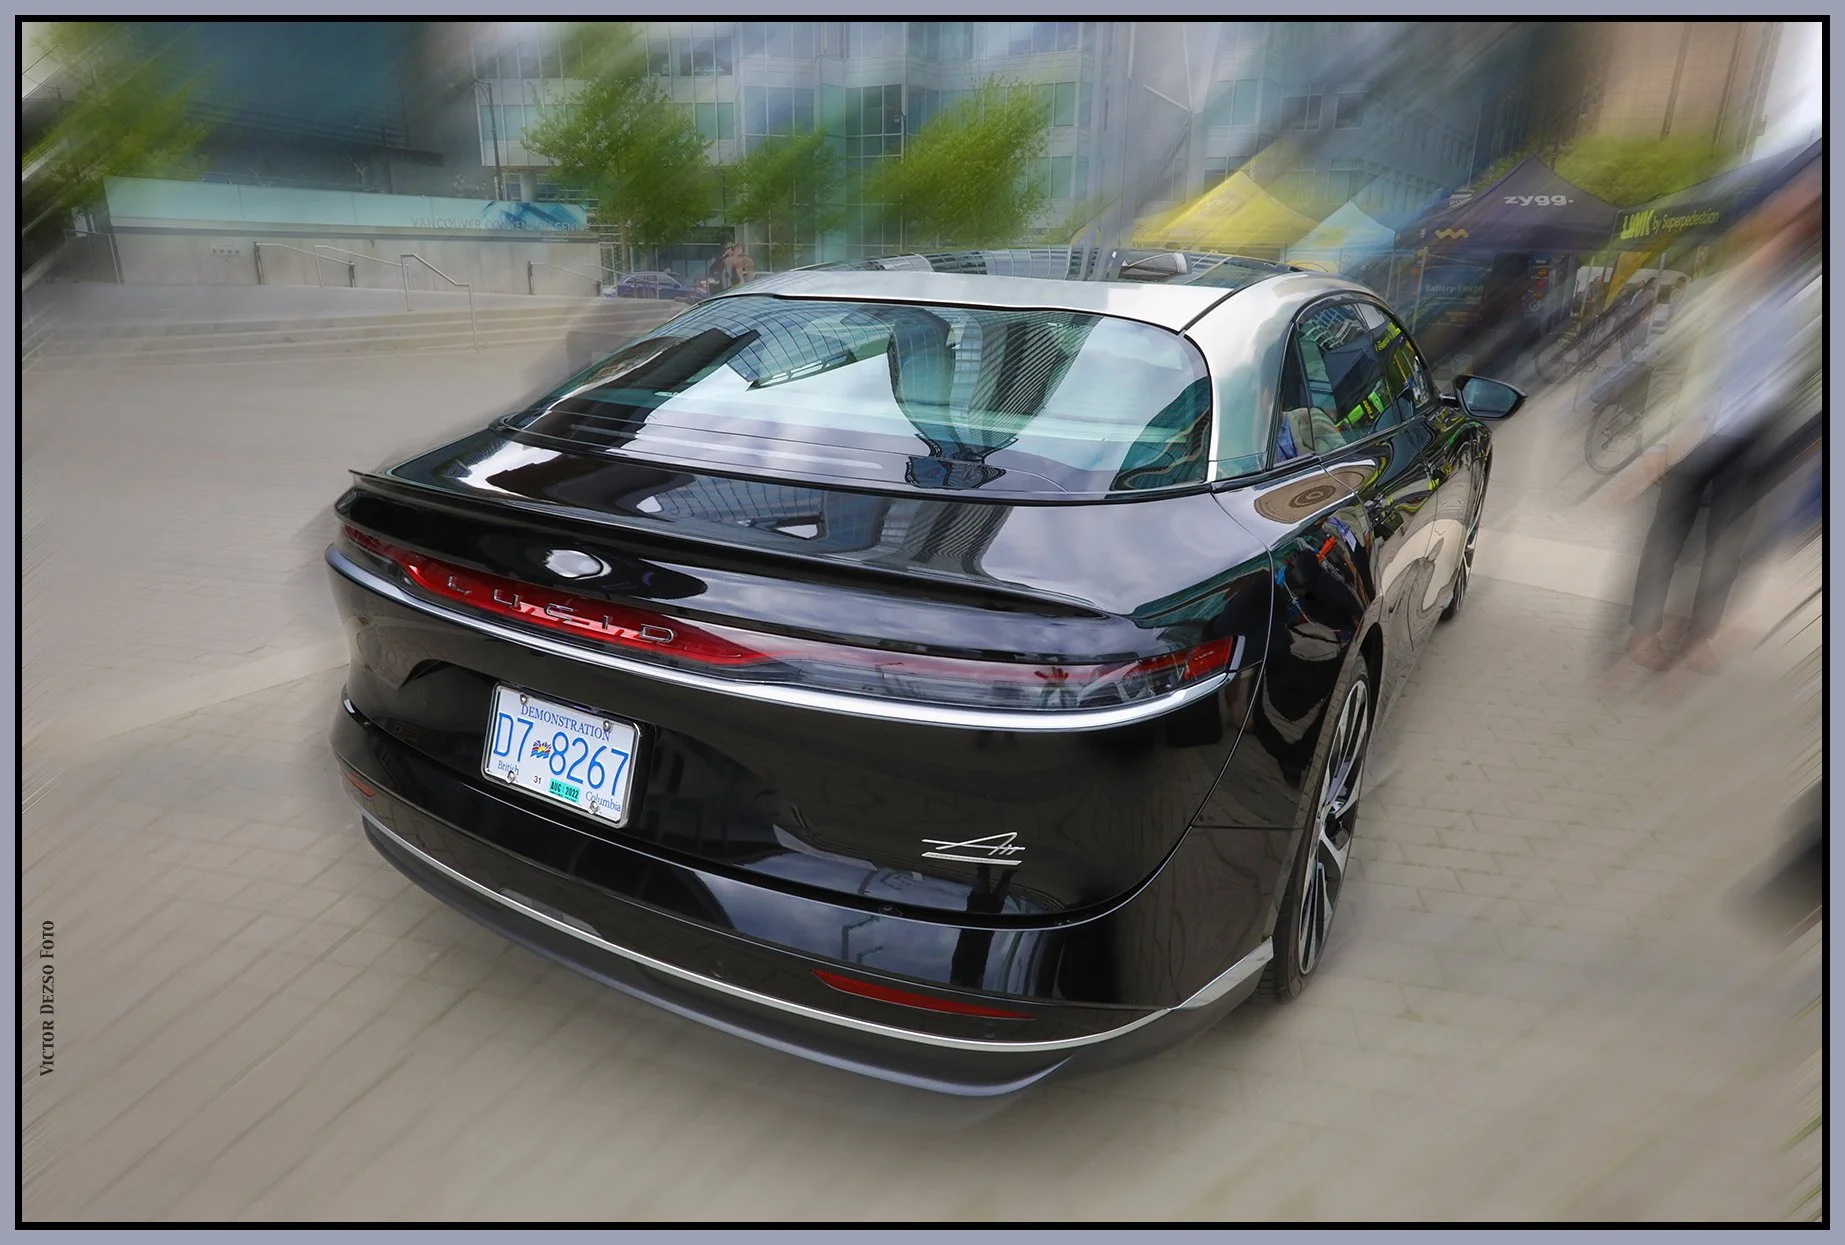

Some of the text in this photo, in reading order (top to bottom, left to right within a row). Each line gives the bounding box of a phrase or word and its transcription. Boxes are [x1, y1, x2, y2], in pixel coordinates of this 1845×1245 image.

[1503, 195, 1575, 207] zygg.
[411, 216, 482, 230] VANCOUVER
[555, 221, 591, 233] CENE
[1652, 215, 1661, 234] by
[1661, 208, 1721, 232] Superpedestrian
[448, 575, 675, 644] LUCID
[520, 704, 612, 742] DEMONSTRATION
[493, 711, 630, 797] D7 8267
[497, 759, 520, 776] British
[533, 776, 542, 785] 31
[550, 780, 562, 793] AUG
[565, 786, 580, 799] 2022
[585, 790, 622, 812] Columbia
